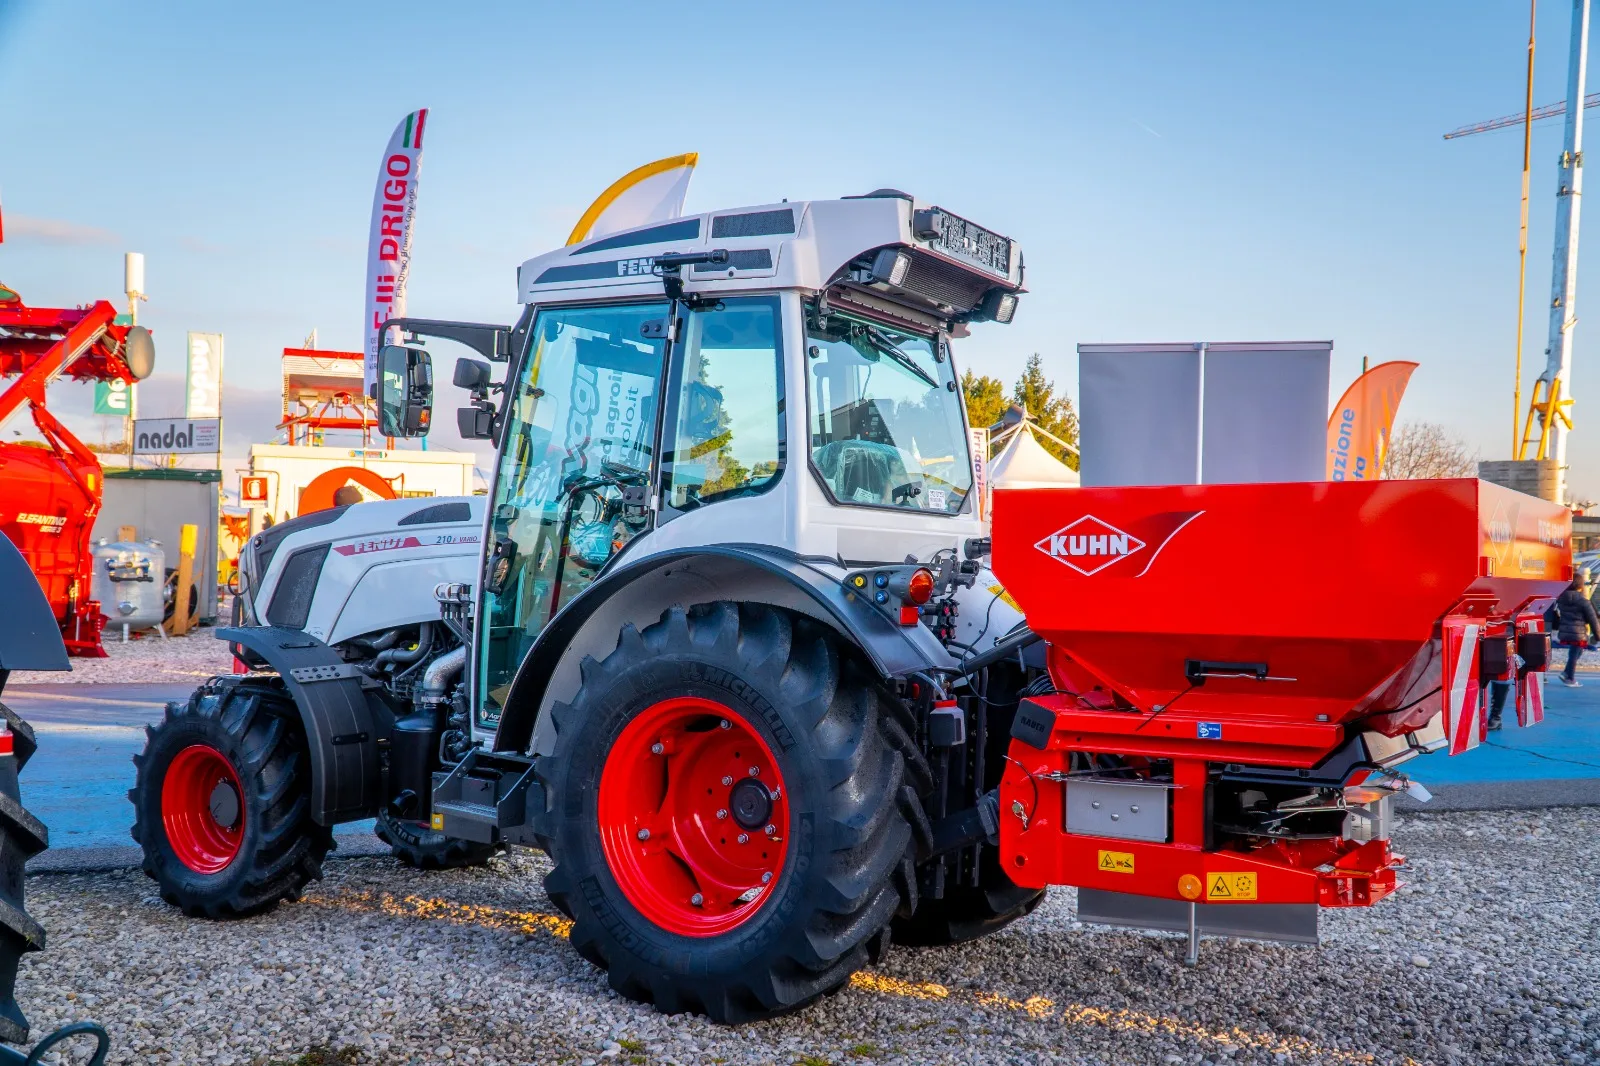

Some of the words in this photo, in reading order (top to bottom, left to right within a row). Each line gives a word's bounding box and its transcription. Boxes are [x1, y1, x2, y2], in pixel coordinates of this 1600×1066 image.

[379, 155, 410, 261] DRIGO
[617, 258, 663, 276] FEN
[138, 423, 193, 449] nadal
[16, 512, 67, 526] ELEFANTINO
[436, 535, 452, 544] 210
[459, 535, 478, 543] VARIO
[1049, 534, 1129, 556] KUHN
[702, 667, 798, 753] MICHELIN
[1020, 715, 1046, 733] RAUCH
